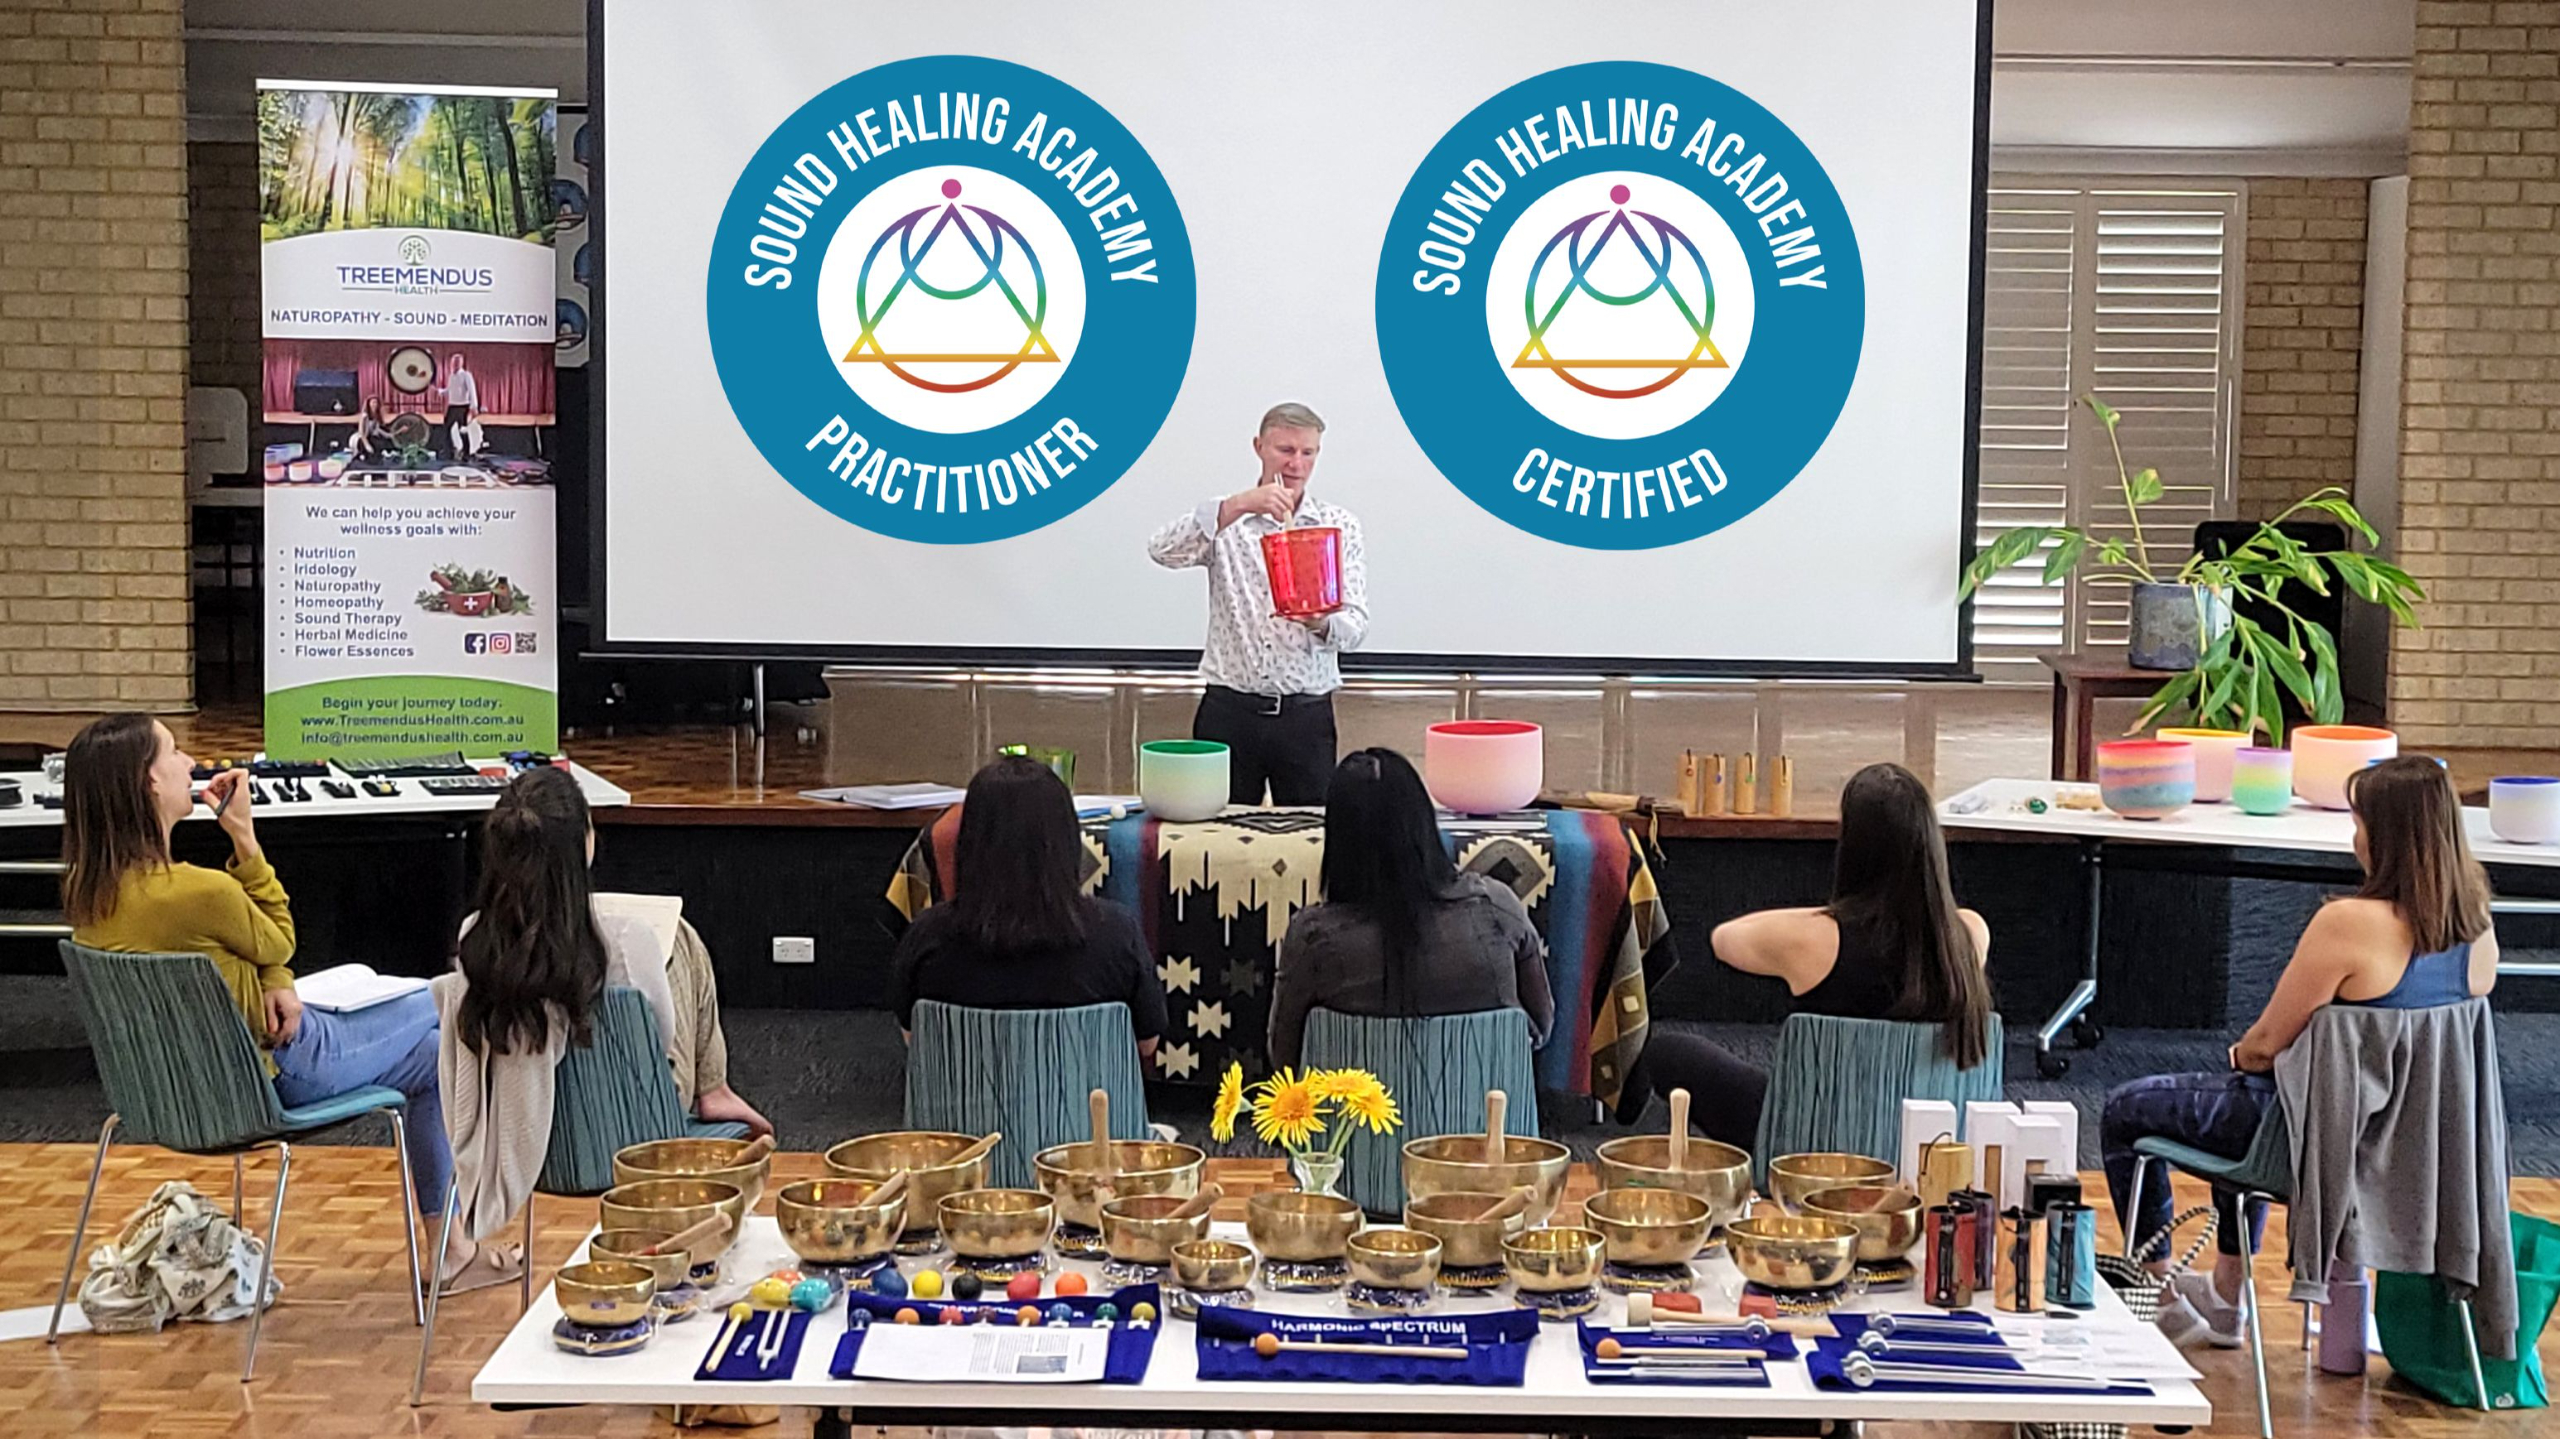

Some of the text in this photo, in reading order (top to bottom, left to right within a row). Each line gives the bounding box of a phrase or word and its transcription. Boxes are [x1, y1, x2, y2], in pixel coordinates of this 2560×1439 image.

[337, 266, 493, 286] TREEMENDUS
[394, 286, 438, 295] HEALTH
[271, 309, 381, 324] NATUROPATHY
[394, 312, 447, 326] SOUND
[460, 313, 548, 327] MEDITATION
[306, 506, 516, 522] We can help you achieve your
[340, 523, 482, 537] wellness goals with:
[294, 547, 356, 559] Nutrition
[294, 563, 357, 577] Iridology
[294, 580, 381, 594] Naturopathy
[294, 596, 384, 611] Homeopathy
[295, 612, 402, 627] Sound Therapy
[295, 629, 408, 641] Herbal Medicine
[295, 645, 414, 657] Flower Essences
[322, 697, 363, 710] Begin
[367, 699, 398, 711] your
[402, 698, 455, 711] journey
[301, 714, 524, 727] www.TreemendusHealth.com.au
[301, 731, 524, 746] info@treemendushealth.com.au
[1271, 1319, 1466, 1334] HARMONIC SPECTRUM
